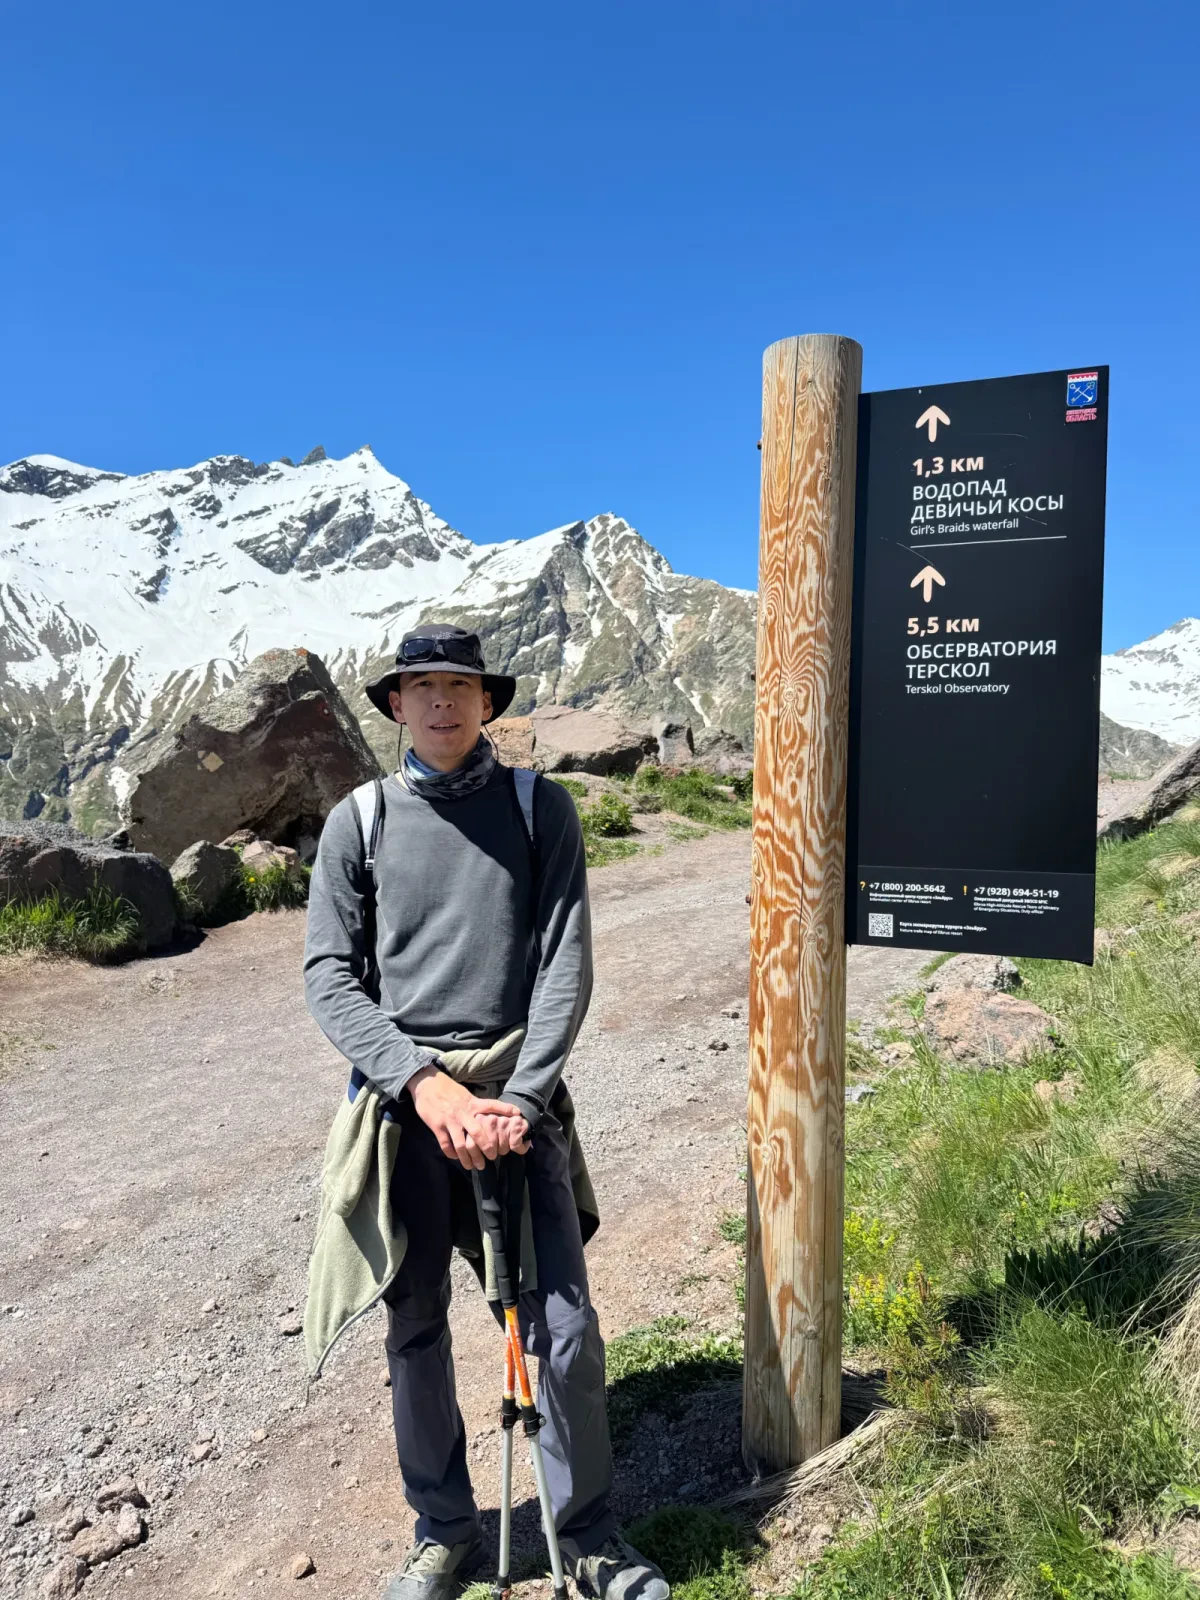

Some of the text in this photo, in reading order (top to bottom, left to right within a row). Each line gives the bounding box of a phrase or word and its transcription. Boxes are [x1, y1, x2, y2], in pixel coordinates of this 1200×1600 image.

[912, 456, 945, 478] 1,3
[912, 478, 1007, 502] ВОДОПАД
[910, 494, 1064, 524] ДЕВИЧЬИ КОСЫ
[910, 518, 1019, 536] Girl's Braids waterfall
[906, 616, 940, 637] 5,5
[906, 640, 1057, 660] ОБСЕРВАТОРИЯ
[905, 662, 990, 679] ТЕРСКОЛ
[905, 683, 1010, 695] Terskol Observatory
[869, 882, 946, 893] +7 (800) 200-5642
[987, 887, 1011, 897] (928)
[1012, 888, 1060, 898] 694-51-19
